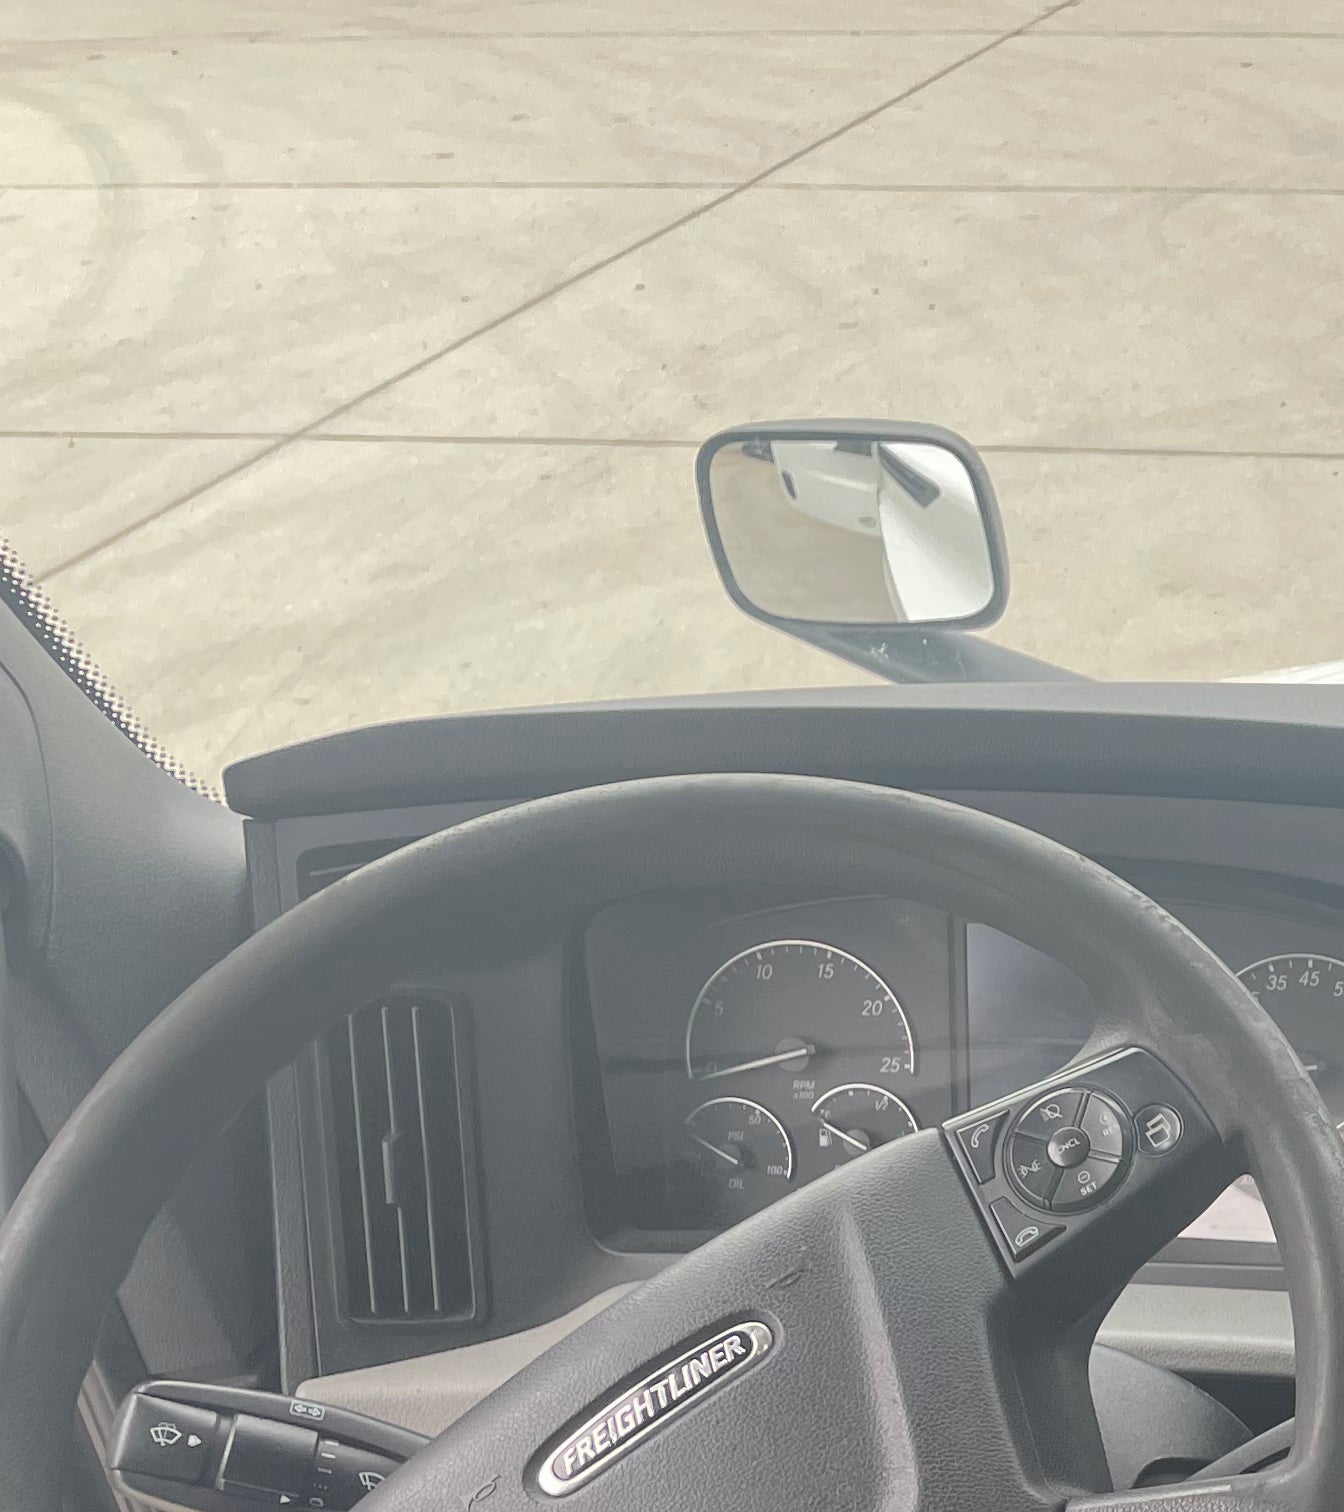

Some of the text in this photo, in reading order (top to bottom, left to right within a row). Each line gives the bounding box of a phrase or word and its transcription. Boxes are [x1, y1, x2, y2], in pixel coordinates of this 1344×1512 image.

[756, 964, 773, 980] 10
[818, 964, 834, 979] 15
[1299, 971, 1320, 986] 45
[1266, 976, 1287, 990] 35
[714, 1003, 724, 1016] 5
[862, 1000, 883, 1016] 20
[880, 1057, 900, 1073] 25
[792, 1080, 815, 1091] RPM
[1057, 1138, 1081, 1154] CNCL
[1079, 1181, 1098, 1197] SET
[563, 1334, 747, 1477] FREIGHTLINER
